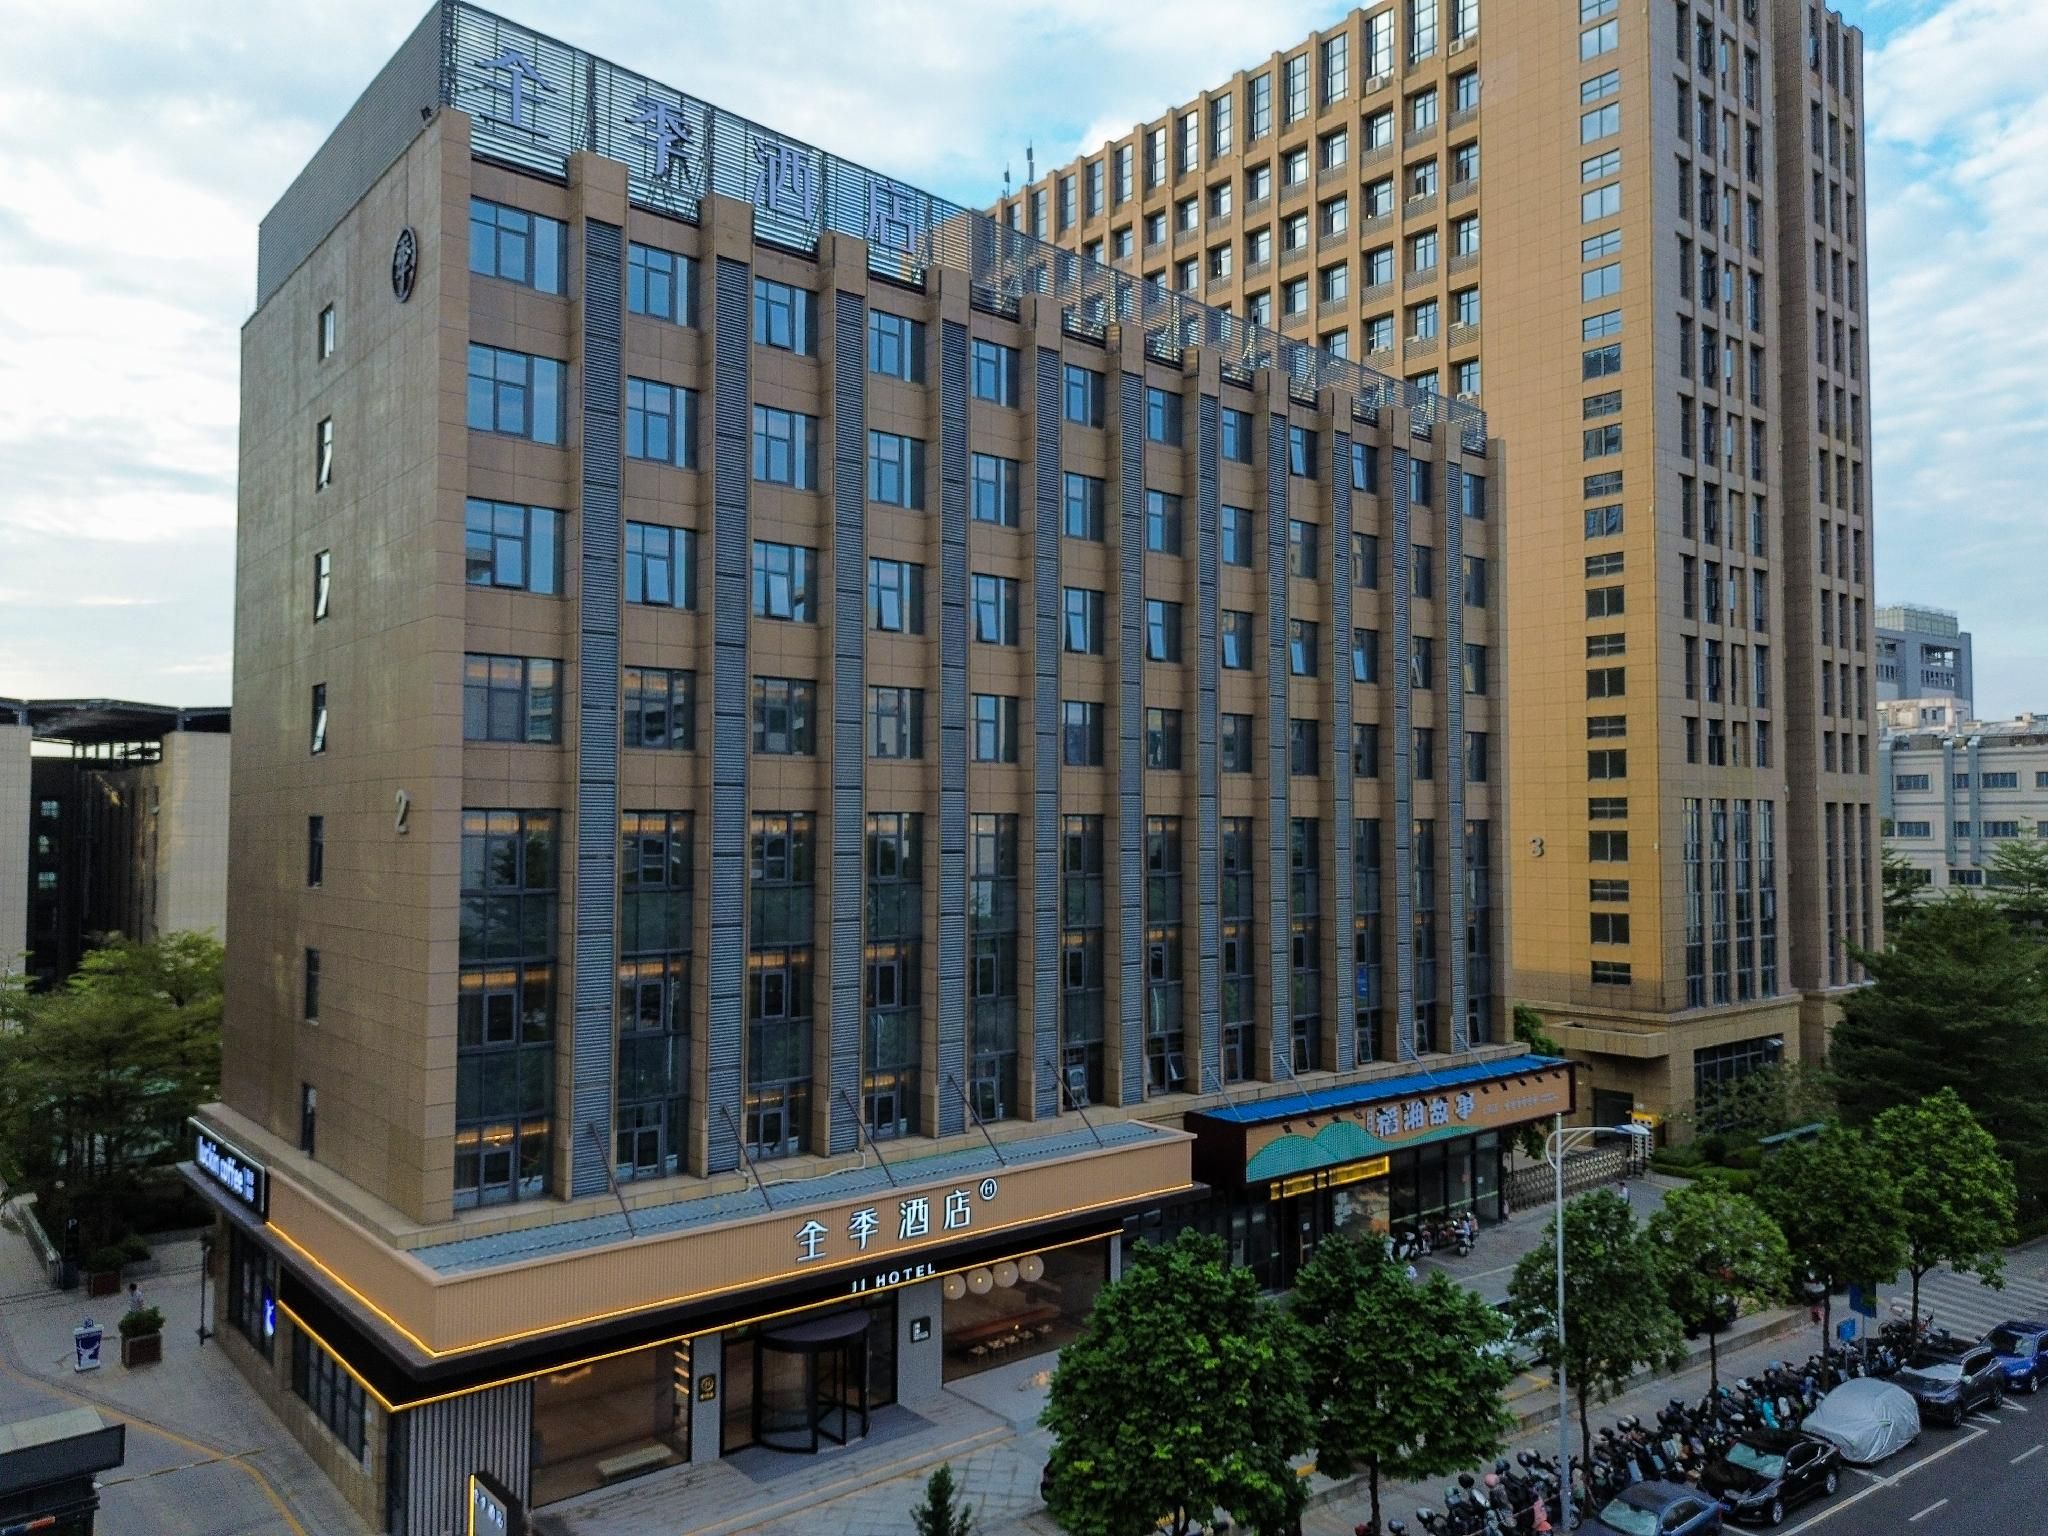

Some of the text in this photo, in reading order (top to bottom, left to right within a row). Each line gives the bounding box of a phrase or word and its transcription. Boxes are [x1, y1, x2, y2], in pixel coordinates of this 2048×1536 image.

[475, 47, 917, 255] 全季酒店
[395, 789, 410, 834] 2
[1529, 837, 1545, 858] 3
[794, 1189, 972, 1263] 全季酒店
[875, 1262, 936, 1288] HOTEL
